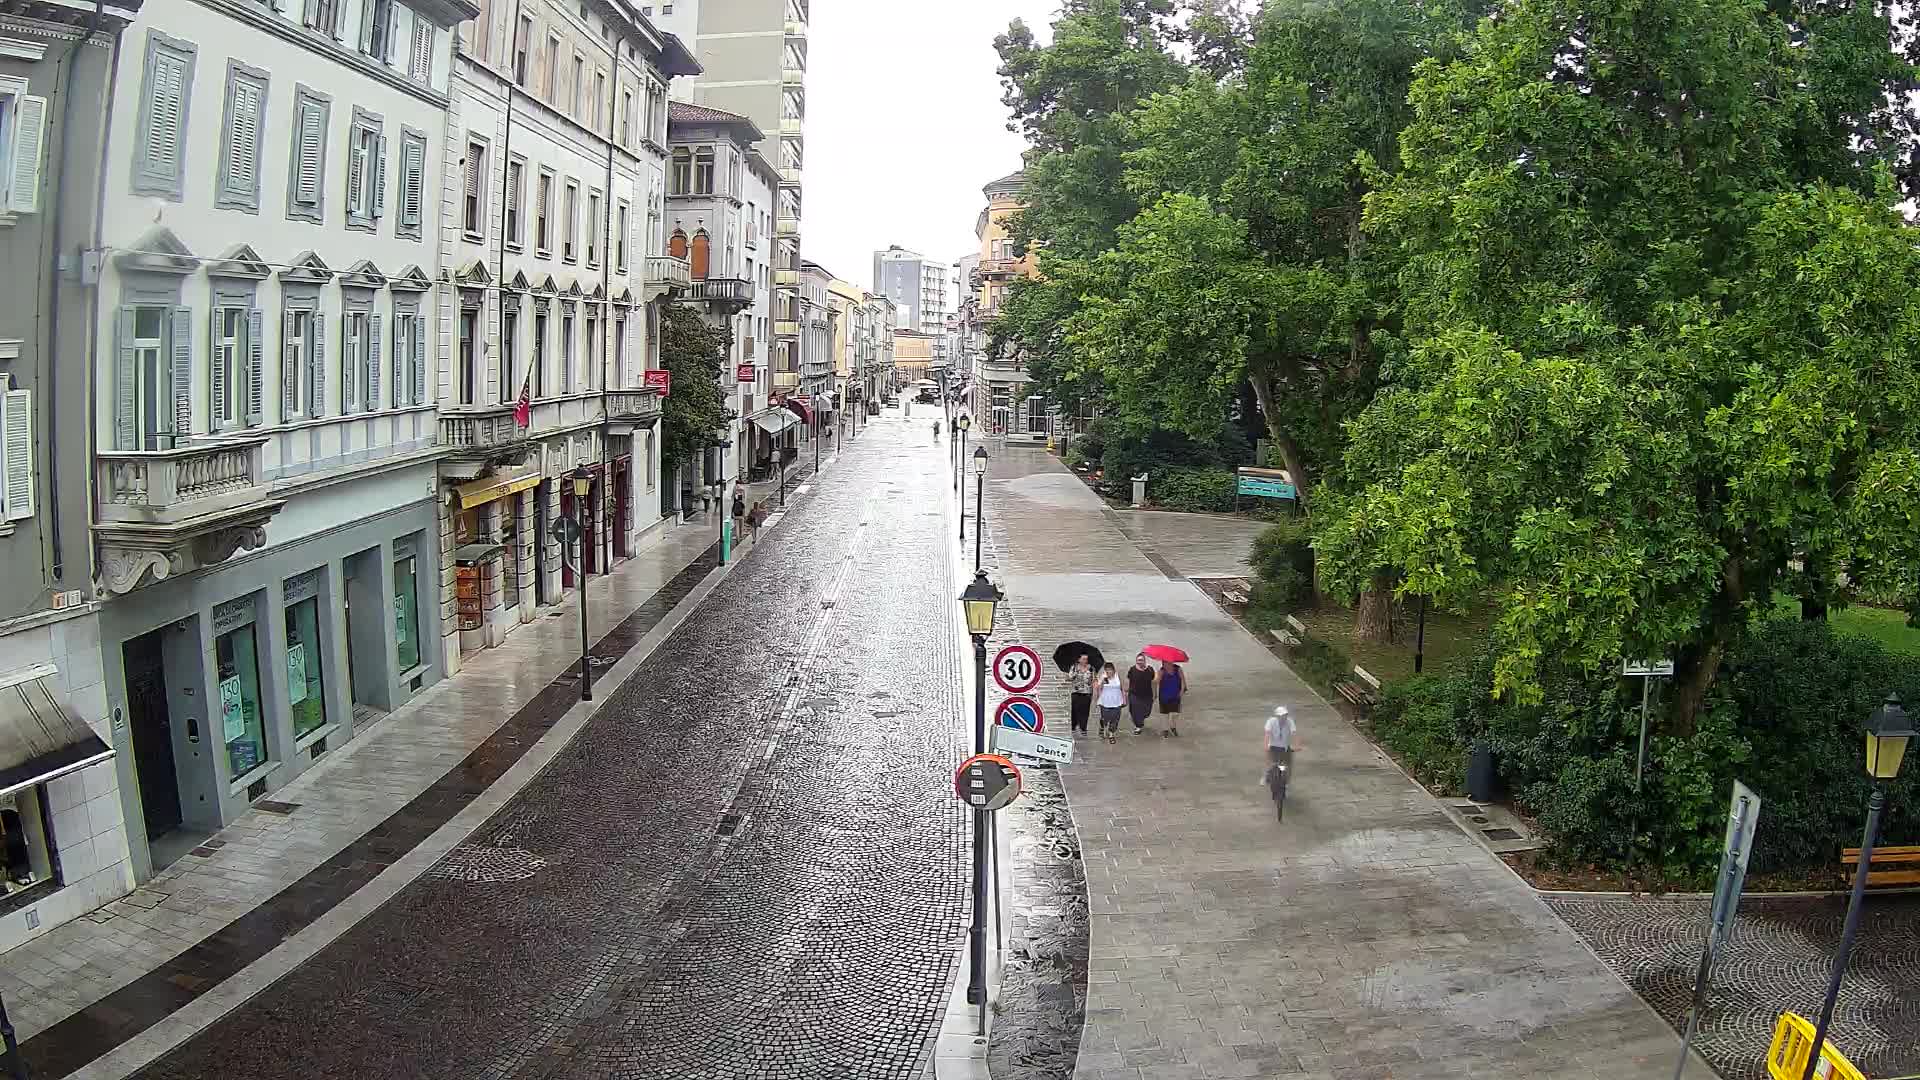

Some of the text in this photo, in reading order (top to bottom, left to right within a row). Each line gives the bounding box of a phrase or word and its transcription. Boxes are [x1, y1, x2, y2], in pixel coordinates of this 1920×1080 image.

[1004, 659, 1031, 680] 30
[220, 679, 239, 702] 130
[1036, 744, 1067, 758] Dante
